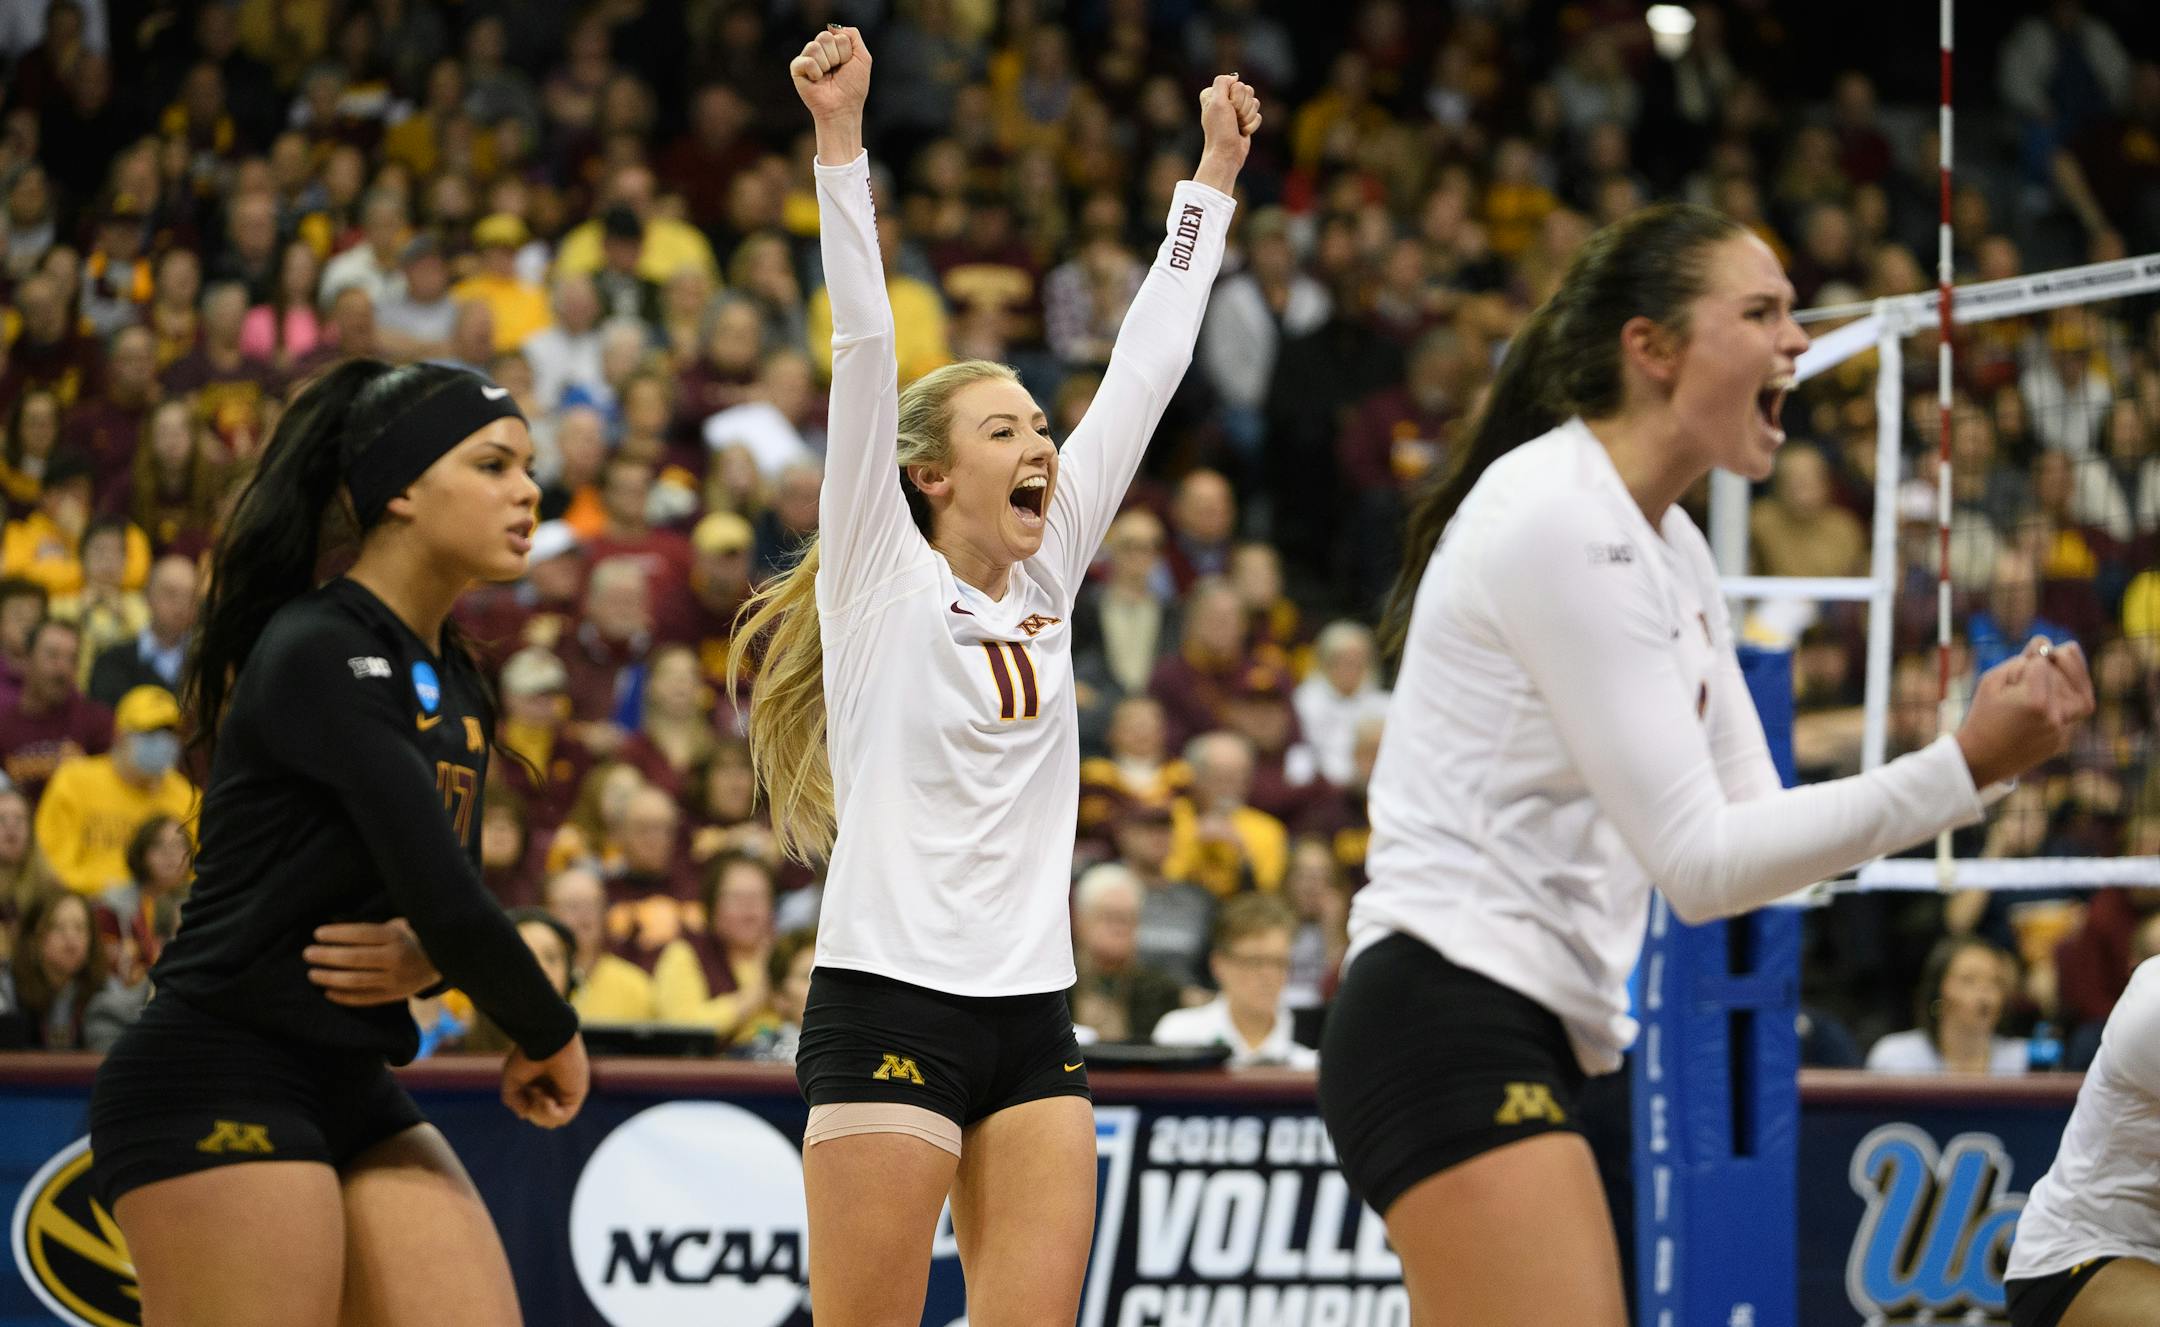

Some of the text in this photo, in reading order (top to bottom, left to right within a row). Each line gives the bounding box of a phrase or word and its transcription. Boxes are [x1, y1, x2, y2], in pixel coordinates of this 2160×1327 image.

[1169, 203, 1204, 271] GOLDEN
[980, 641, 1039, 720] 11
[872, 1053, 925, 1085] M
[1494, 1083, 1565, 1124] M
[196, 1120, 274, 1152] M
[1148, 1116, 1264, 1164] 2016
[603, 1230, 809, 1284] NCAA
